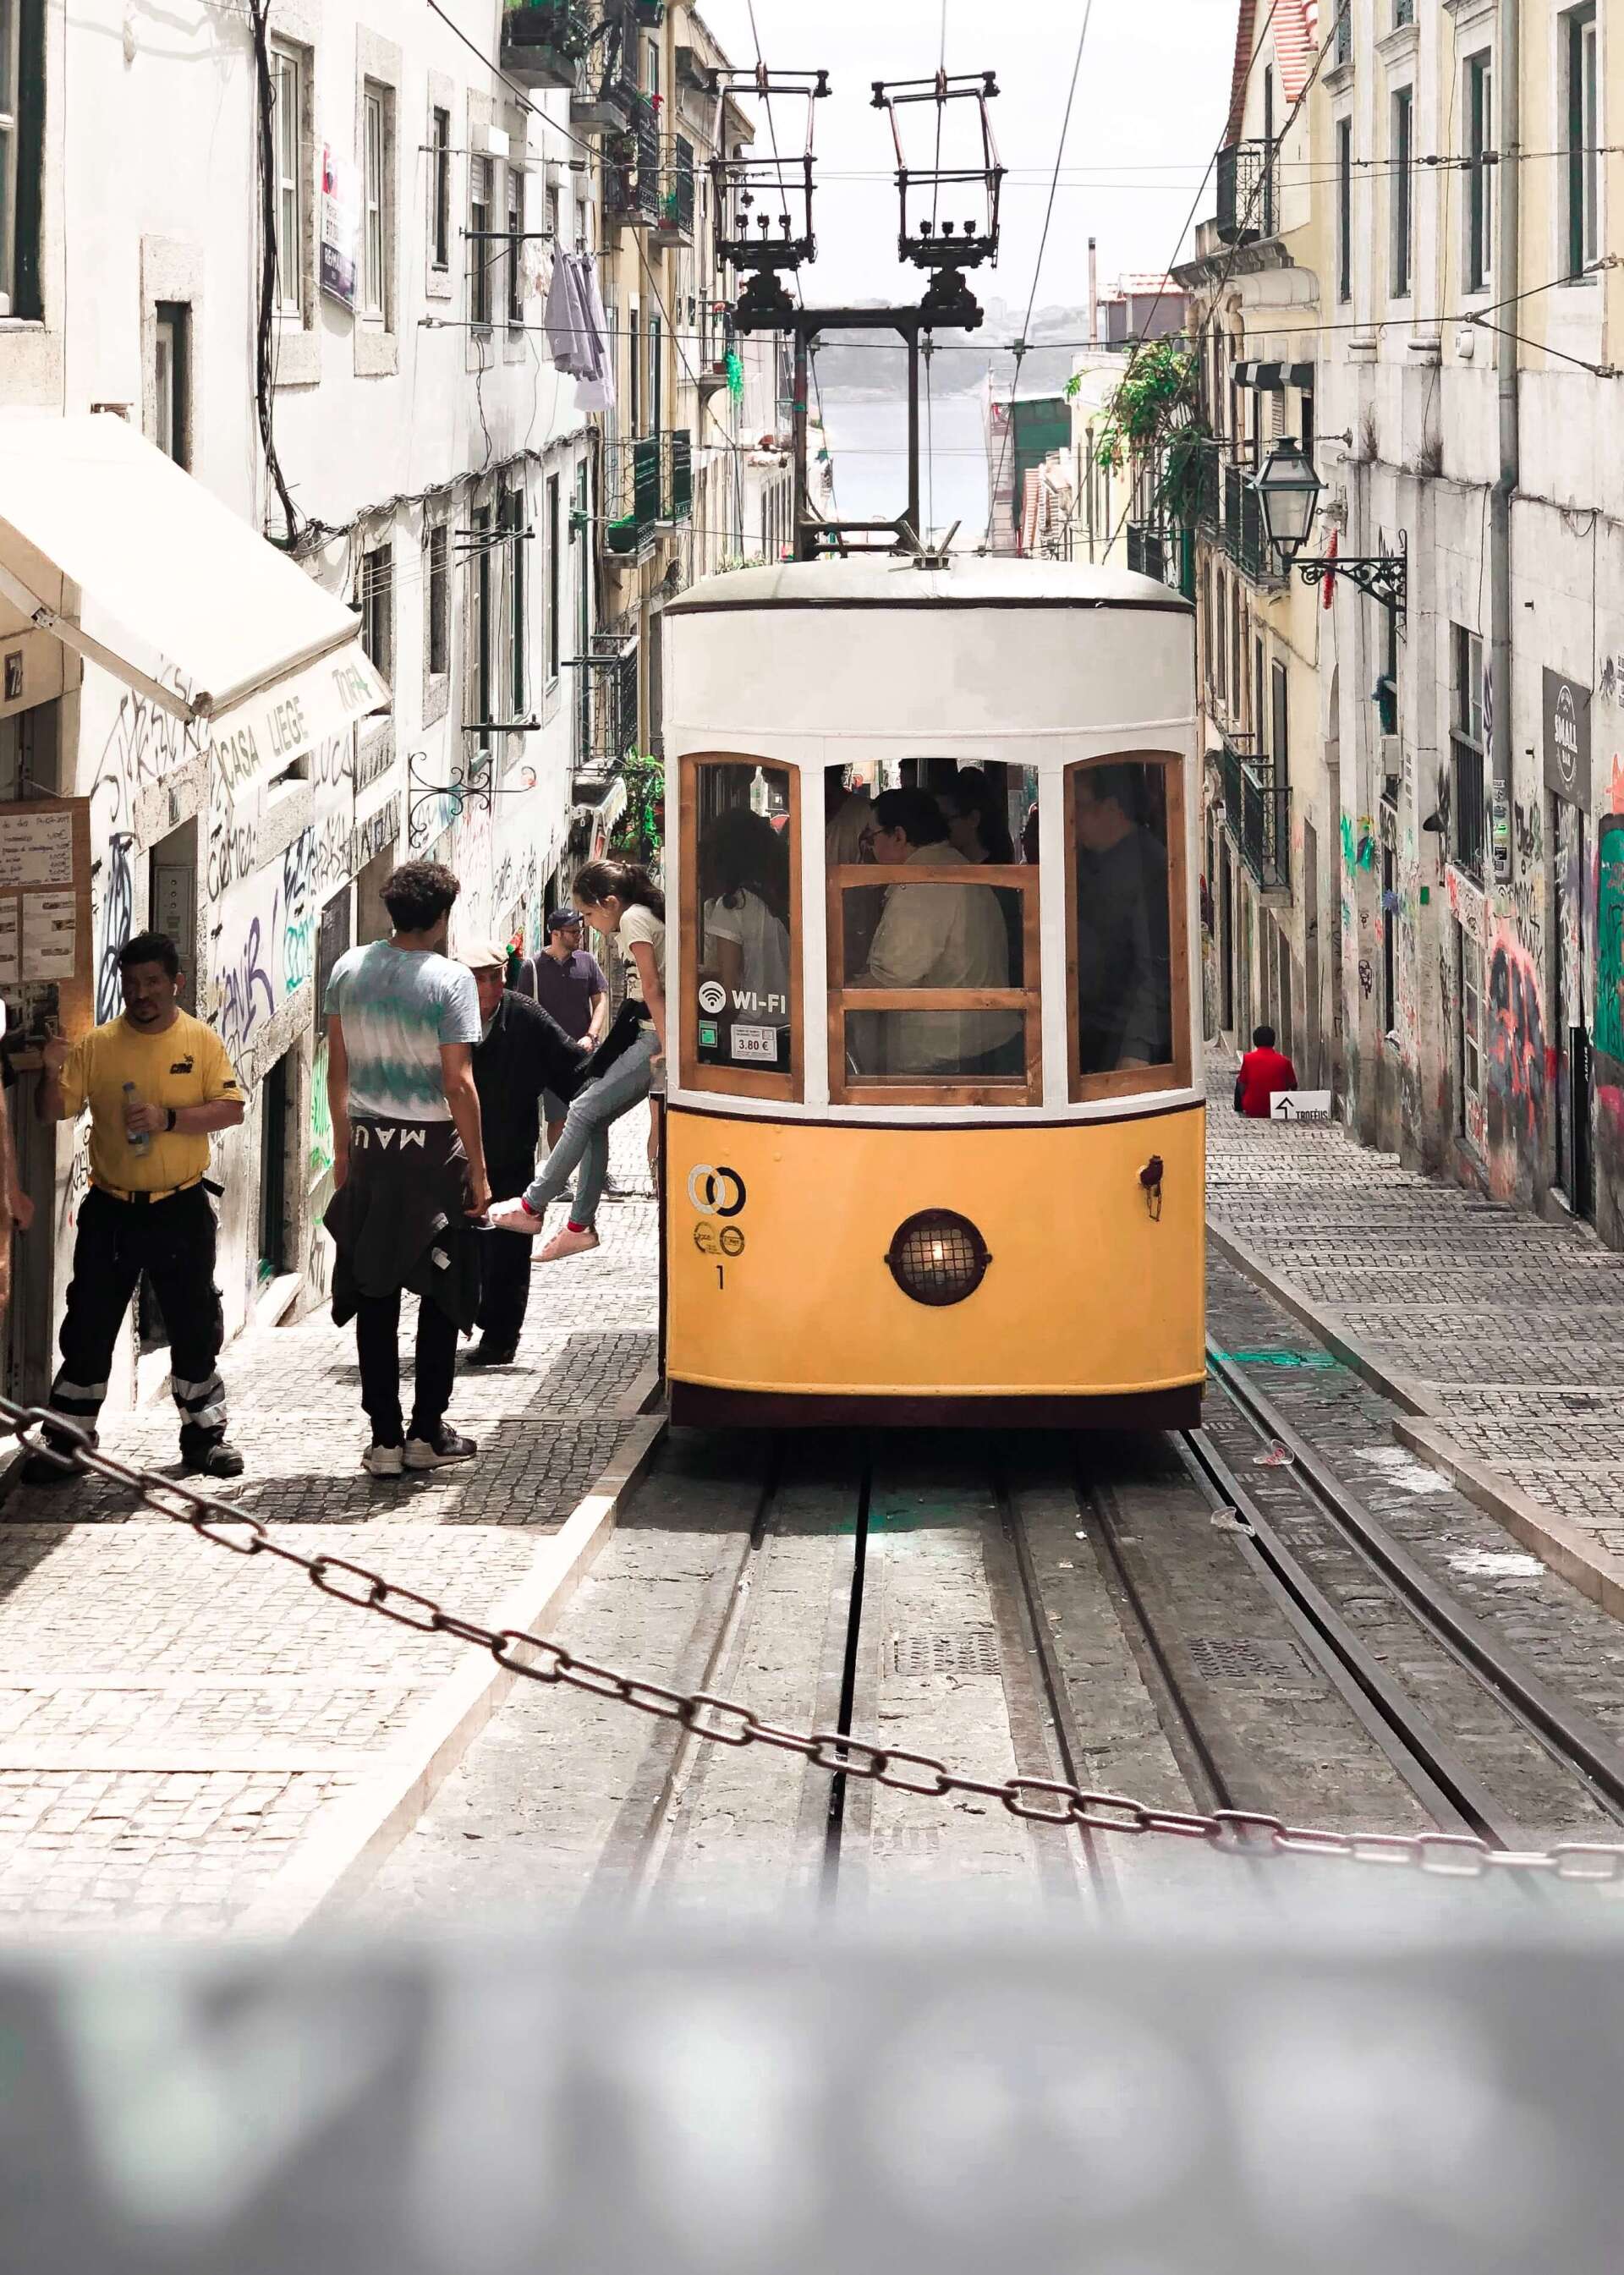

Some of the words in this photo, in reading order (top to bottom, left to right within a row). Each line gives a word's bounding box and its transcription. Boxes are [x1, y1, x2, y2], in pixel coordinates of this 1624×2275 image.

[220, 725, 261, 791] CASA
[266, 696, 309, 757] LIEGE
[1554, 714, 1578, 754] SMALL
[731, 989, 786, 1015] WI-FI
[738, 1039, 760, 1050] 3.80
[762, 1041, 770, 1051] €
[351, 1125, 426, 1150] MAU
[716, 1264, 724, 1291] 1
